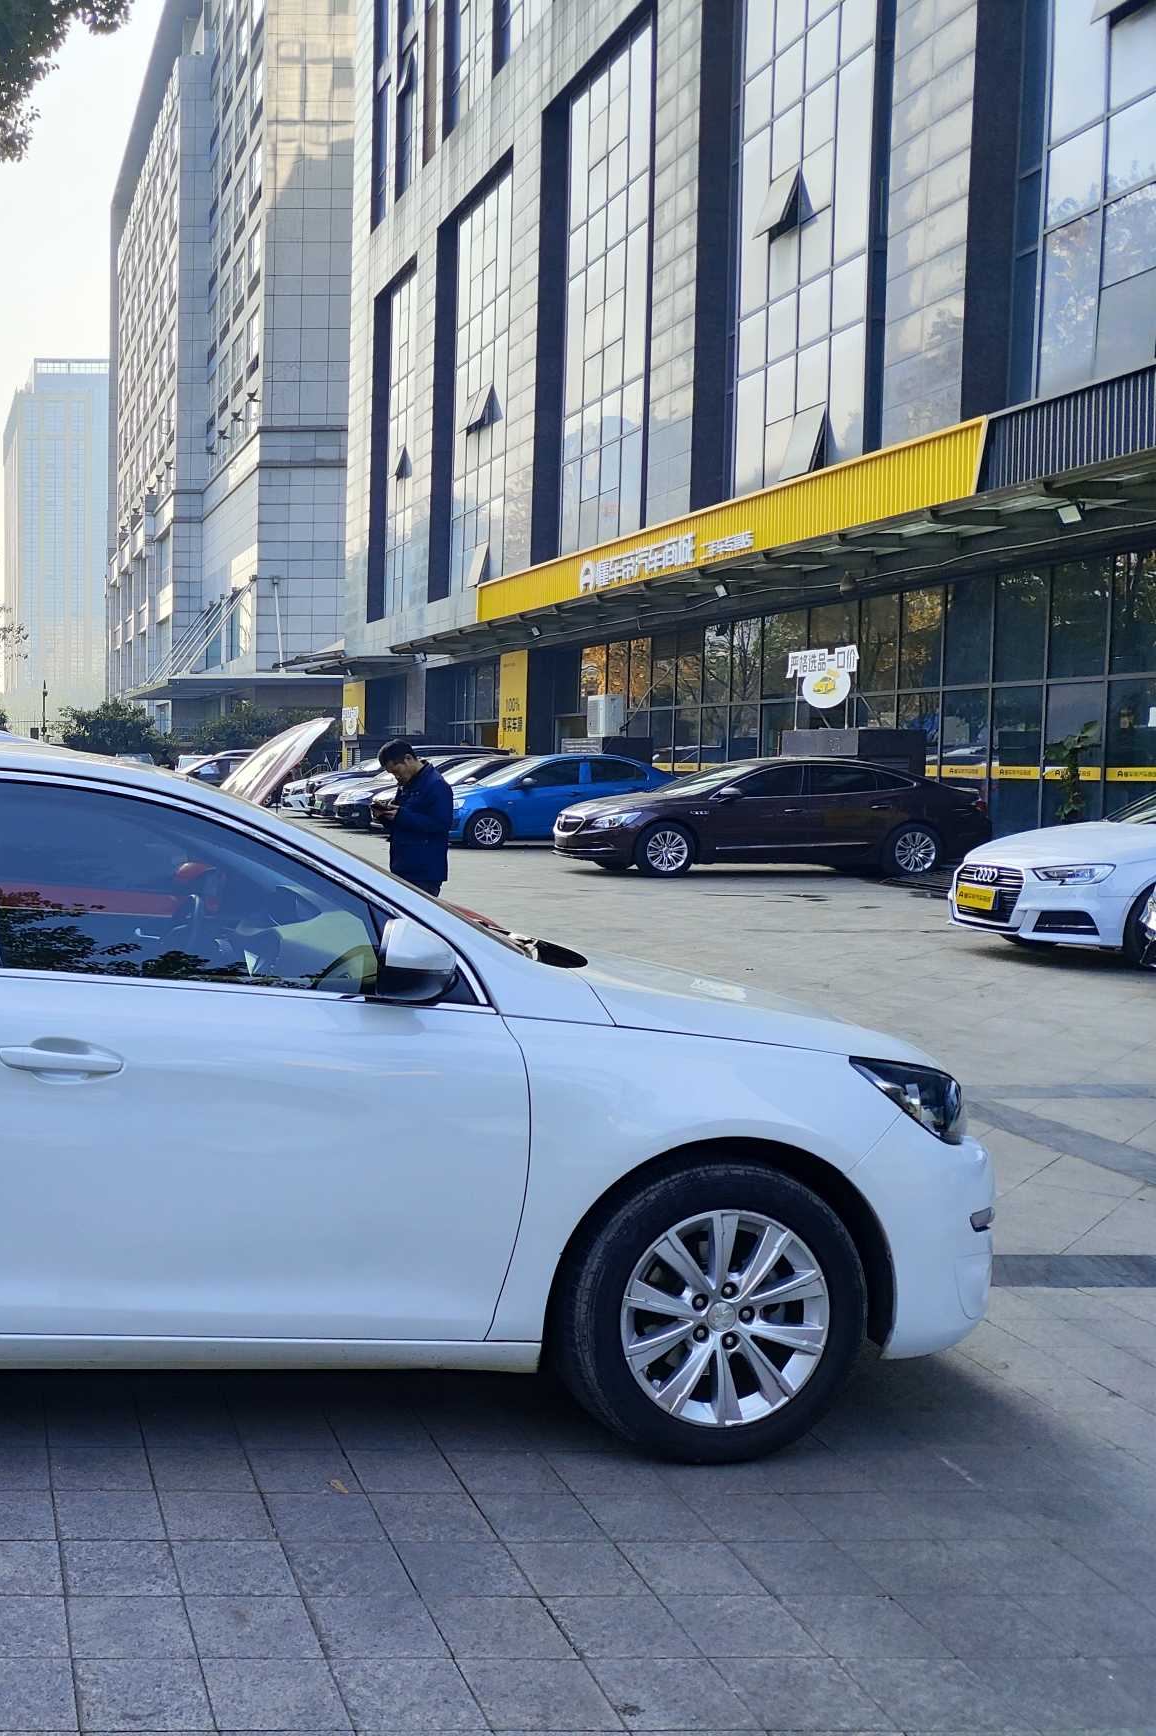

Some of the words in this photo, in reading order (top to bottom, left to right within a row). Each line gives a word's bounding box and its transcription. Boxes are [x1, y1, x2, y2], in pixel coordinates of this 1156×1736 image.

[787, 646, 858, 676] 严格选品一口价
